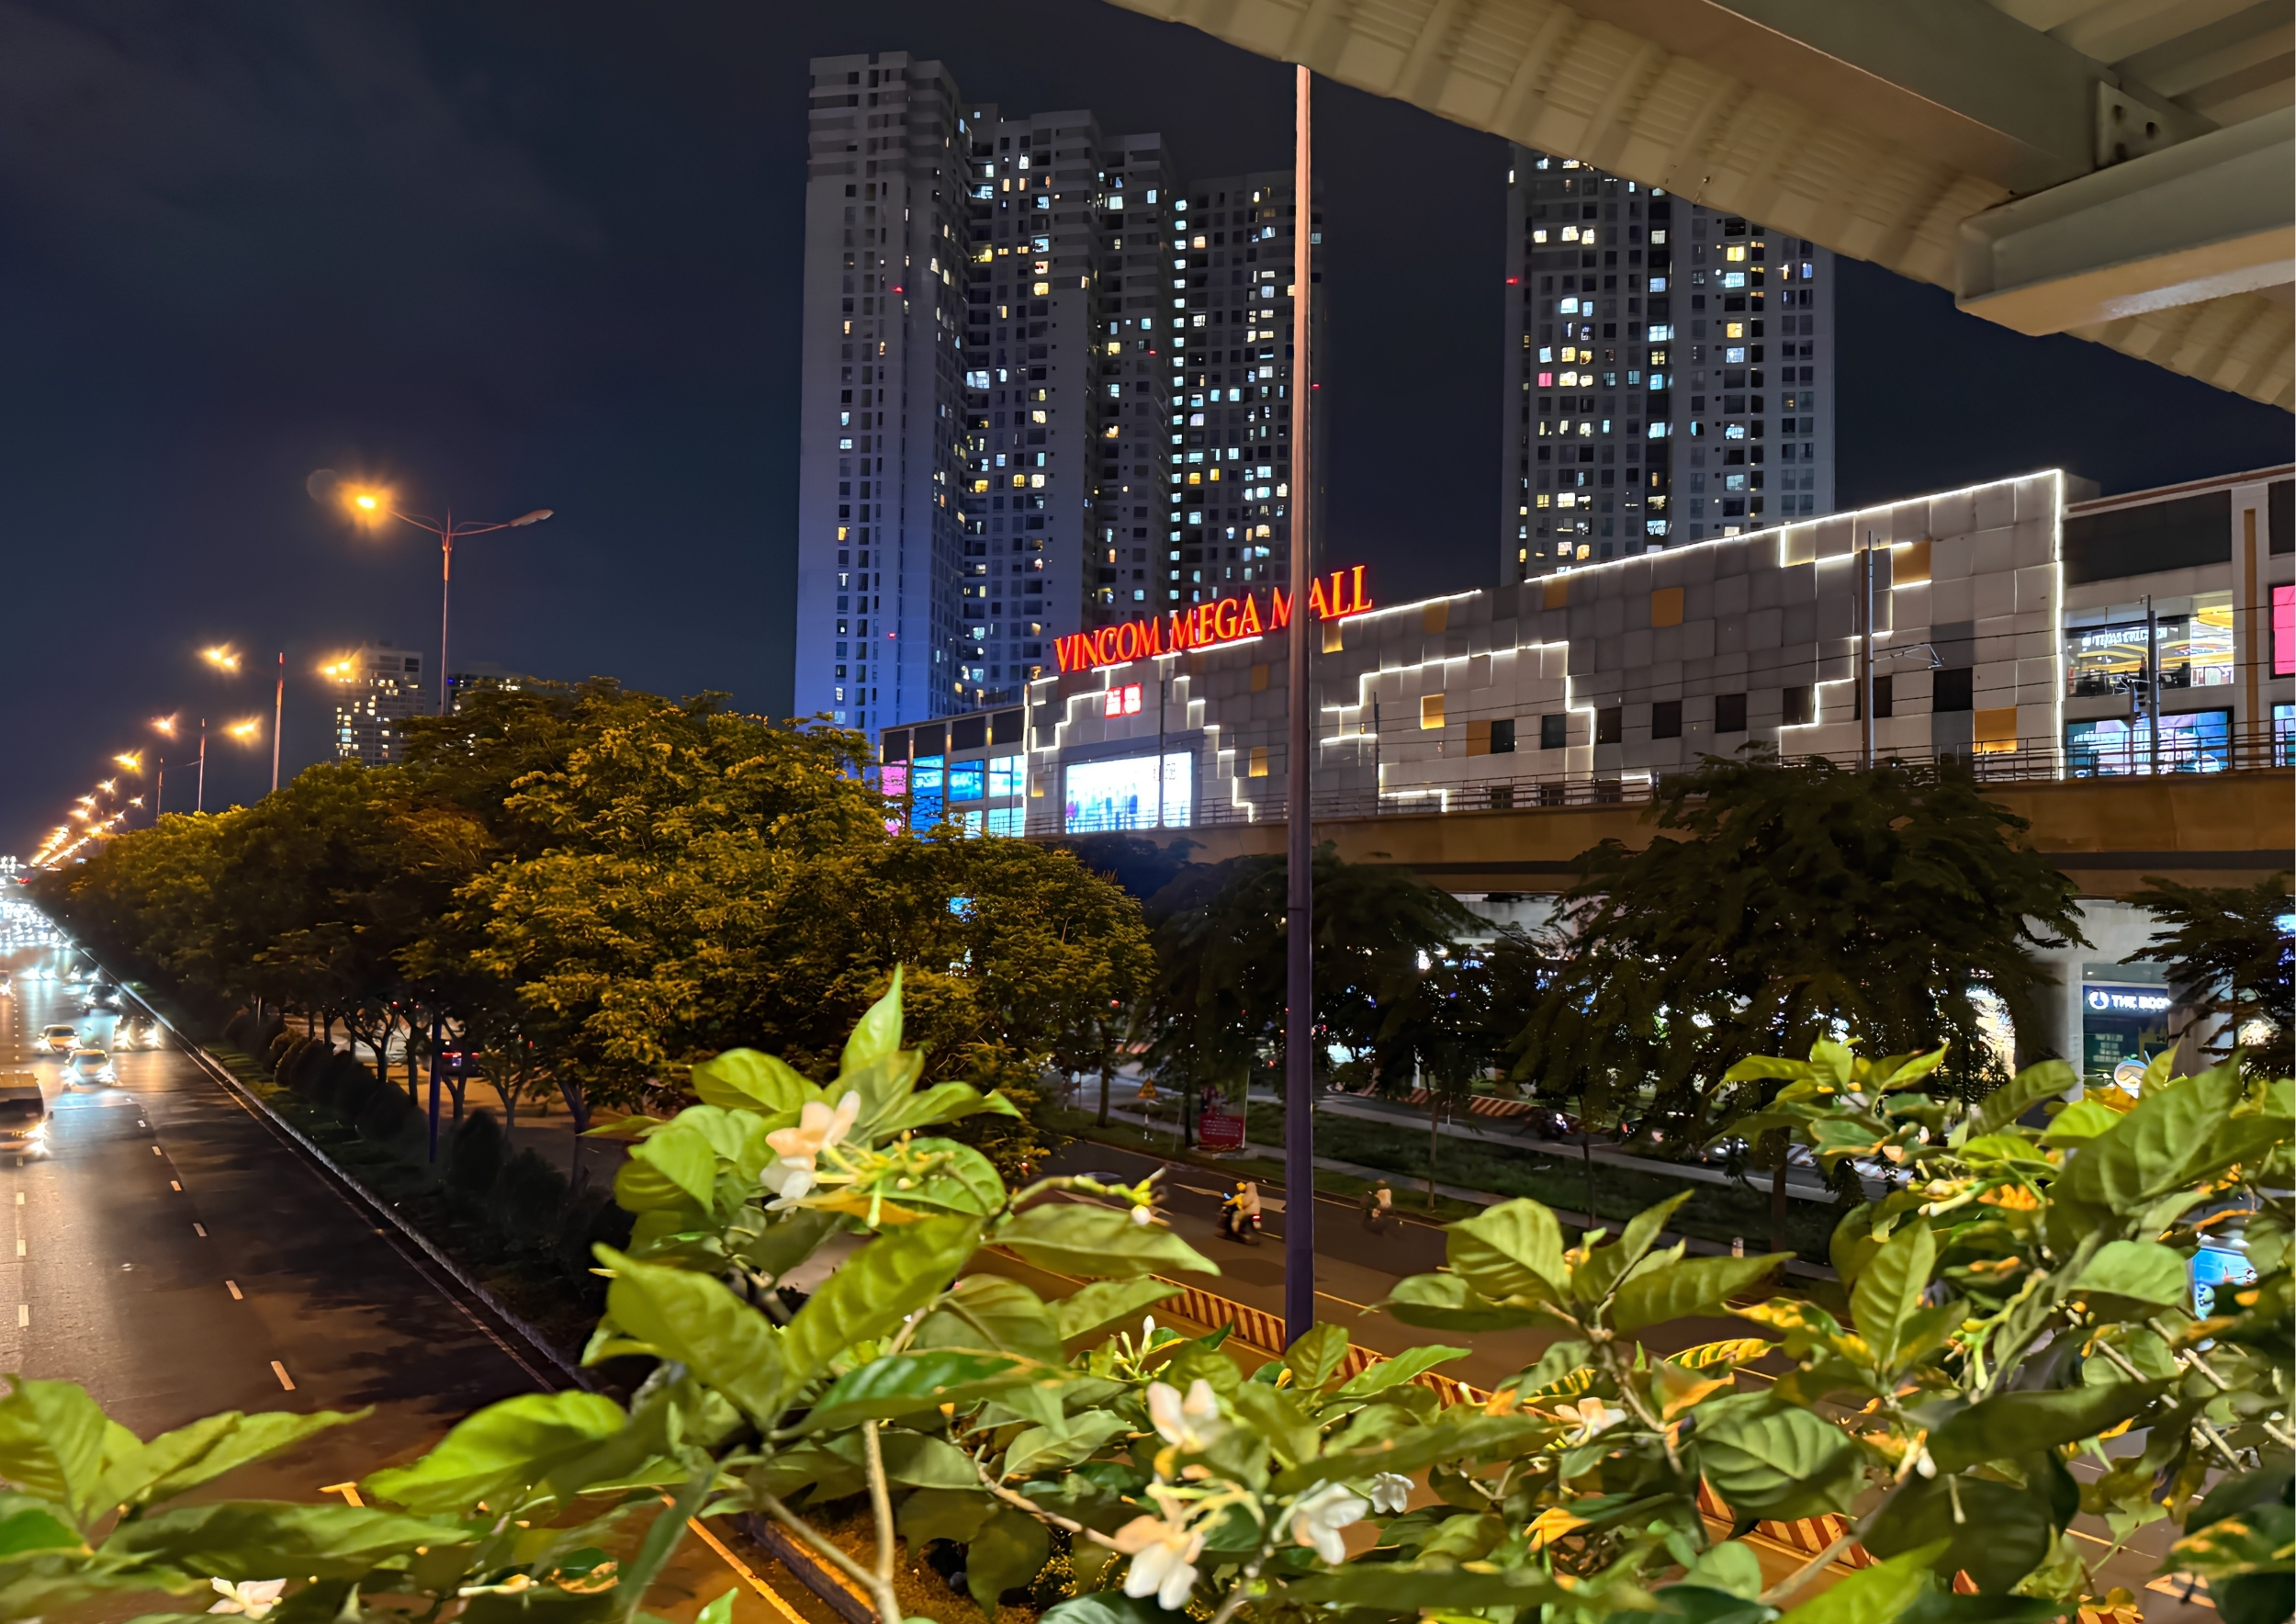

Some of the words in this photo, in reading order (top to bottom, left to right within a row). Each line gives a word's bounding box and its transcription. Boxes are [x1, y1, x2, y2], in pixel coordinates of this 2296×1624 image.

[1053, 615, 1164, 673] VINCOM
[1169, 592, 1263, 652] MEGA
[1268, 565, 1373, 631] MALL
